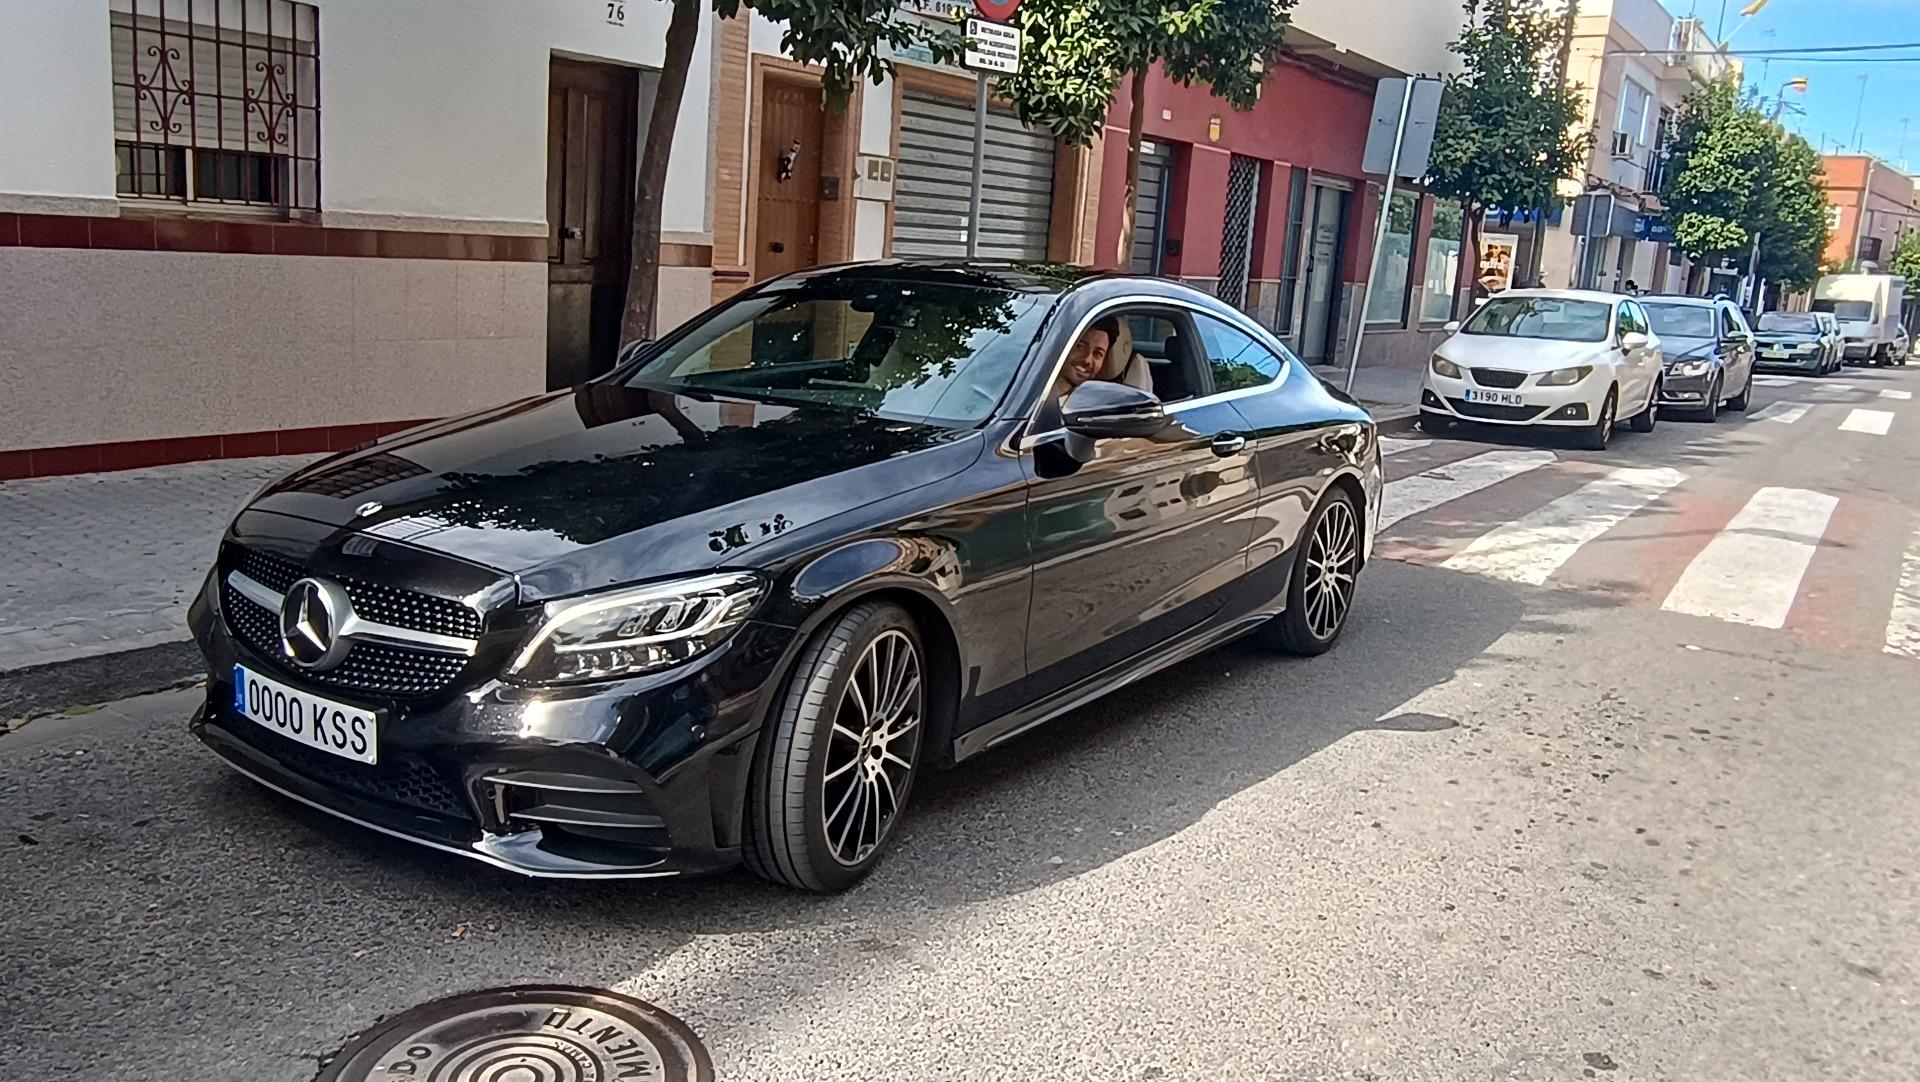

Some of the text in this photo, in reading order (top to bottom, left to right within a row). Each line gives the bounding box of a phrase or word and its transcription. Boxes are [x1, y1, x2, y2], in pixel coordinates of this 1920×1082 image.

[607, 3, 625, 21] 76
[1472, 390, 1522, 405] 3190 HLD
[249, 679, 367, 755] 0000 KSS
[543, 1010, 652, 1082] MIENTO
